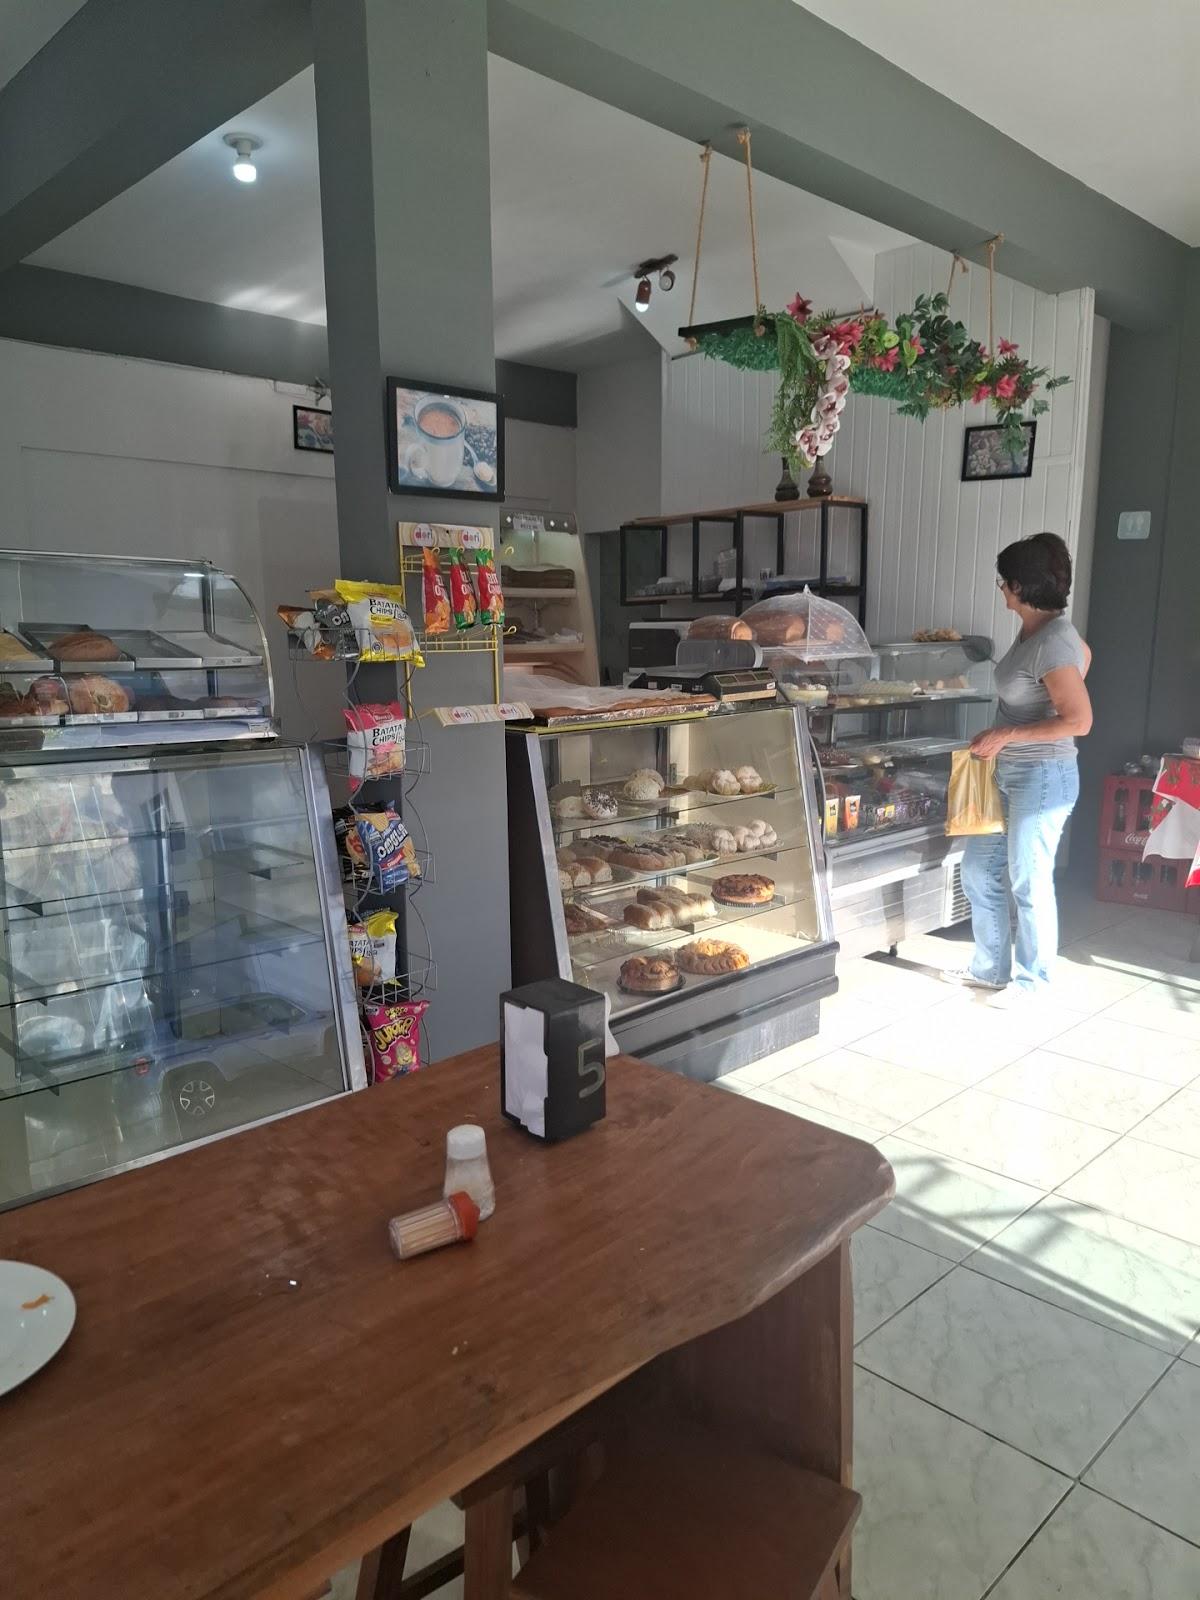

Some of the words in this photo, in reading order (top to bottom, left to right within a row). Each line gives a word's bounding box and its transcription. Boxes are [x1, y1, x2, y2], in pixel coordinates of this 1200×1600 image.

[415, 528, 432, 540] dori
[463, 531, 480, 542] dori
[454, 710, 472, 719] dori
[372, 724, 403, 738] BATATA
[578, 1038, 606, 1098] 5
